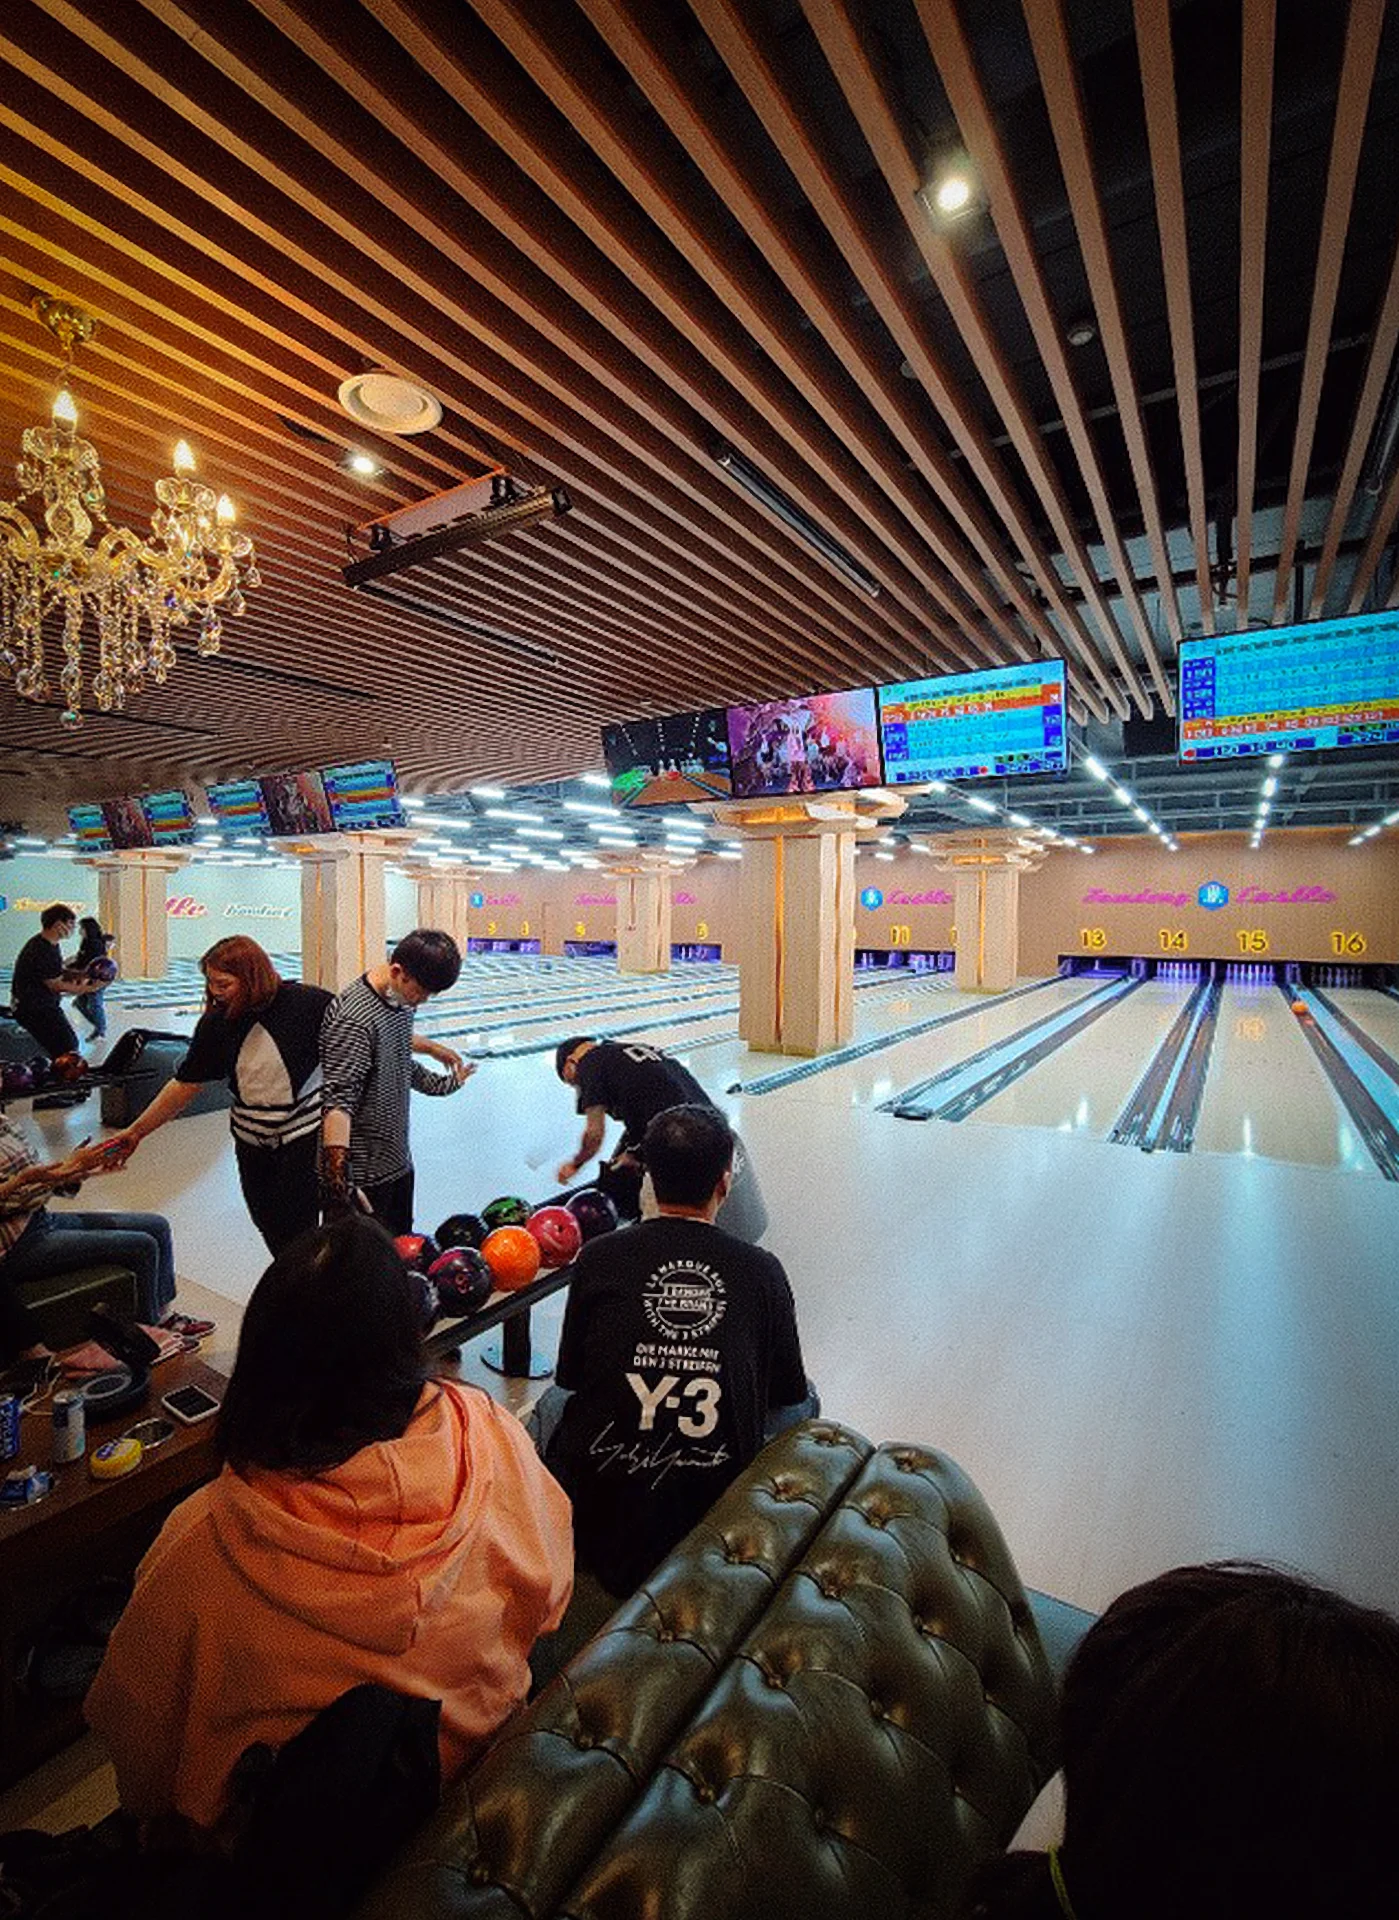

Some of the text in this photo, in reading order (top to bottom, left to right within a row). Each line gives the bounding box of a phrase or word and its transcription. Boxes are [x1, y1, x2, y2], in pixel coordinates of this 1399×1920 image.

[1080, 927, 1107, 951] 13
[1158, 928, 1188, 951] 14
[1236, 929, 1270, 953] 15
[1330, 931, 1367, 955] 16
[625, 1372, 722, 1438] Y-3
